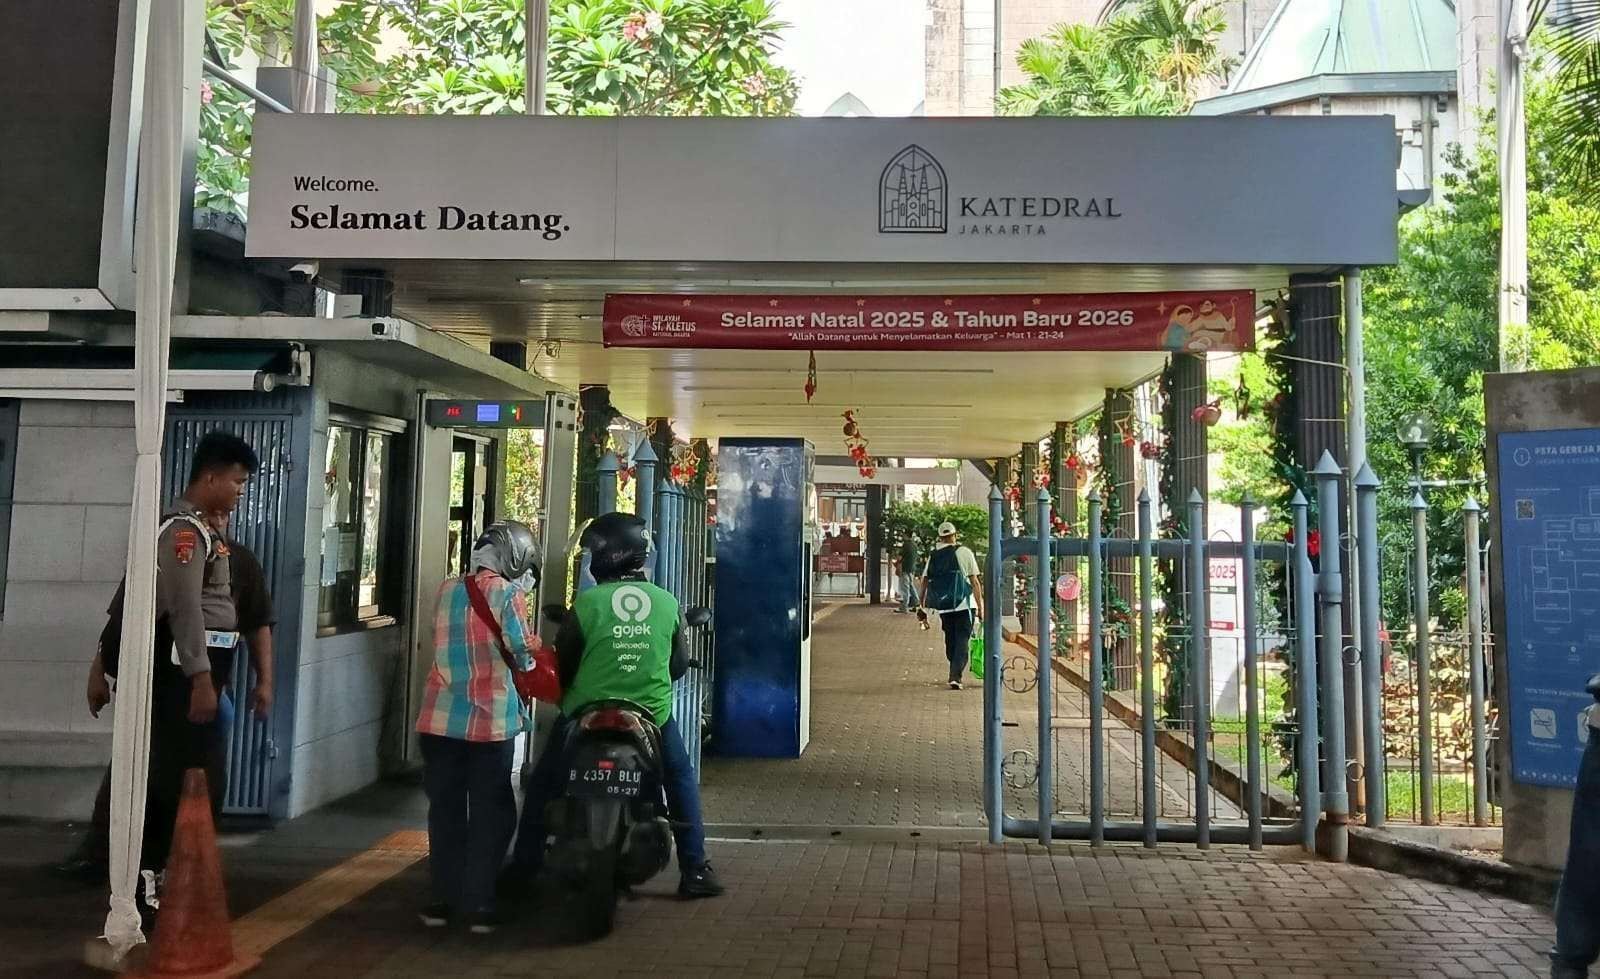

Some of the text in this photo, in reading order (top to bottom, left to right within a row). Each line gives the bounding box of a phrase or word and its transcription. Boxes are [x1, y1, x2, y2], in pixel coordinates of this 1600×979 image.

[294, 176, 379, 192] Welcome.
[960, 197, 1122, 218] KATEDRAL
[290, 204, 570, 241] Selamat Datang.
[959, 224, 1046, 235] JAKARTA
[652, 321, 697, 332] ST. KLETUS
[721, 310, 1134, 328] Selamat Natal 2025 & Tahun Baru 2026
[817, 332, 850, 342] Datang
[852, 332, 878, 341] untuk
[880, 332, 952, 342] Menyelamatkan
[1007, 331, 1025, 339] Mat
[1038, 331, 1064, 339] 21-24
[613, 623, 651, 638] gojek
[569, 769, 641, 783] B 4357 BLU
